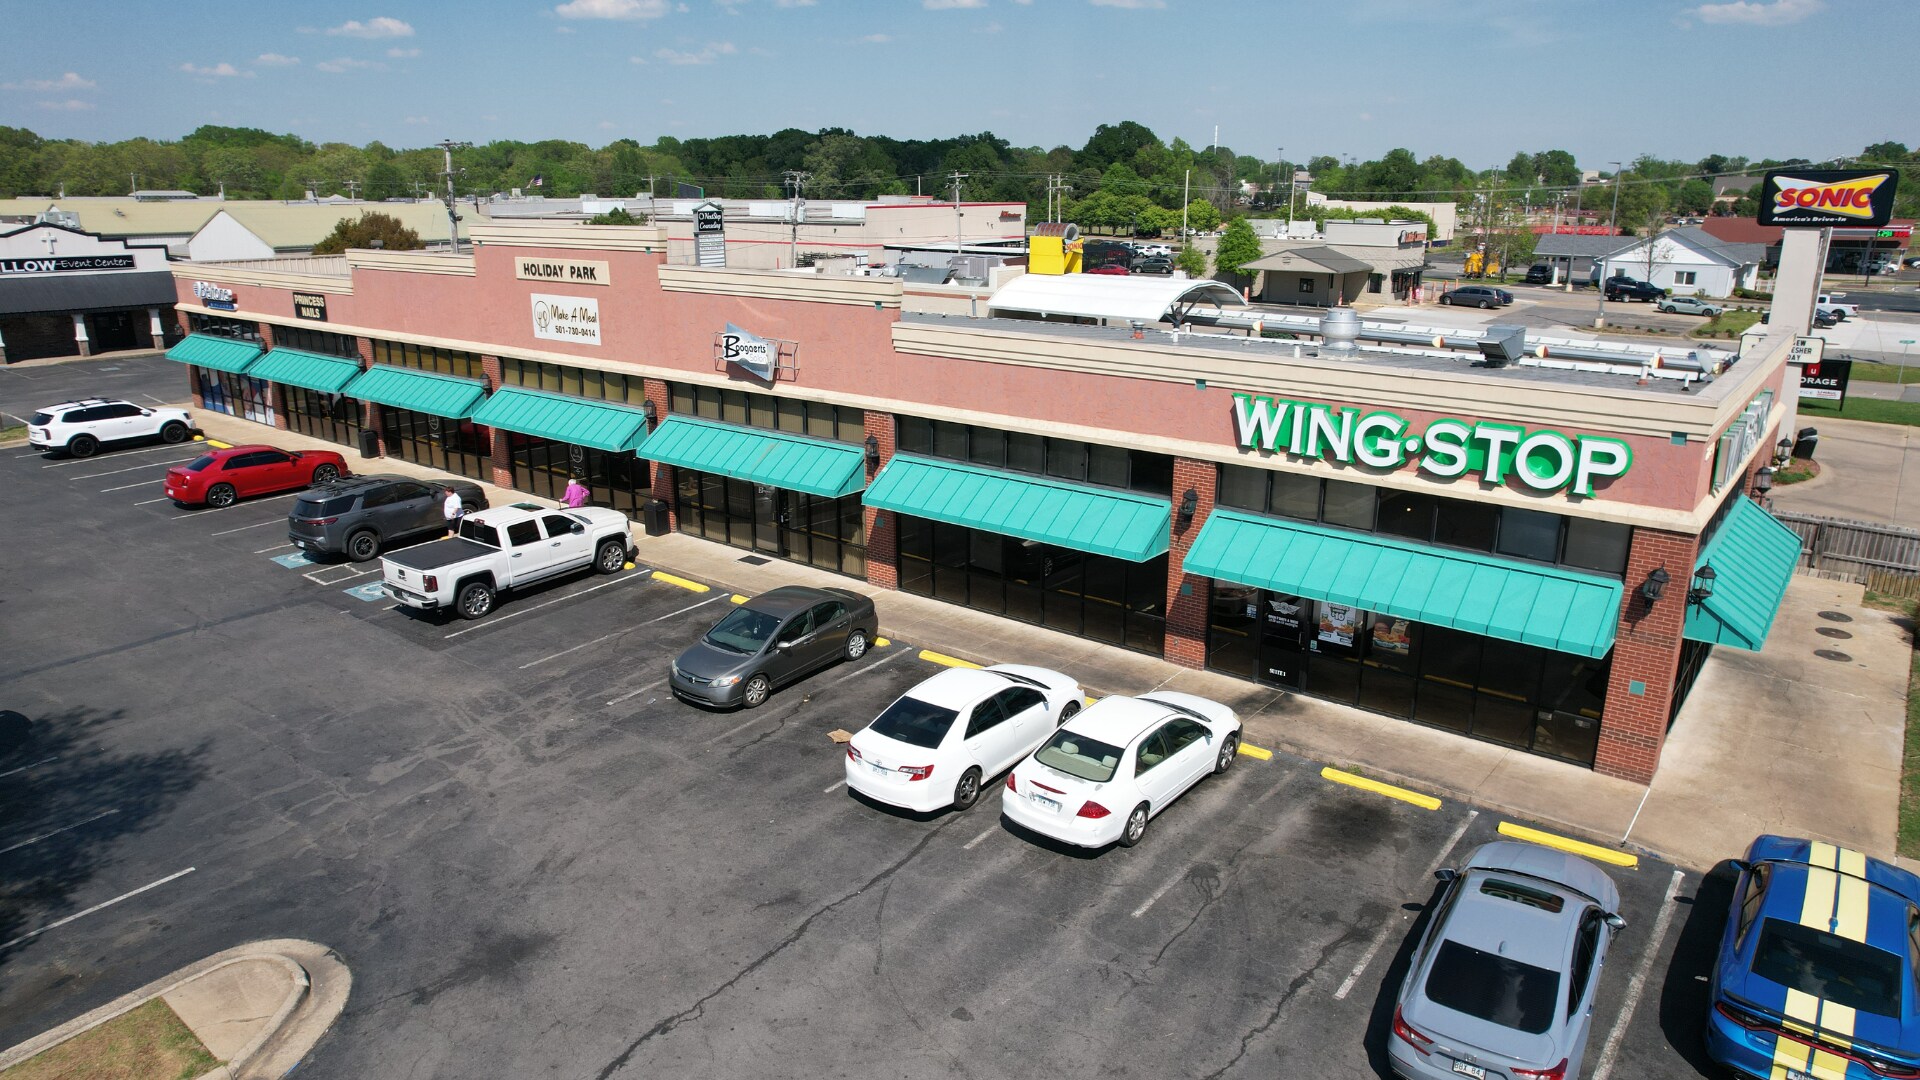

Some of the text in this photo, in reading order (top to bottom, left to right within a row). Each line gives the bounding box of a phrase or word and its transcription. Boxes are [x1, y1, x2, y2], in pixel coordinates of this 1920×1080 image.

[1778, 188, 1873, 208] SONIC
[60, 260, 92, 268] Event
[94, 258, 128, 267] Center
[523, 262, 597, 280] HOLIDAY PARK
[200, 282, 232, 301] Beltone
[294, 294, 325, 307] PRINCESS
[301, 308, 320, 319] NAILS
[550, 304, 597, 324] Make A Meal
[555, 325, 596, 337] 501-730-0414
[722, 335, 767, 358] Boogaerts
